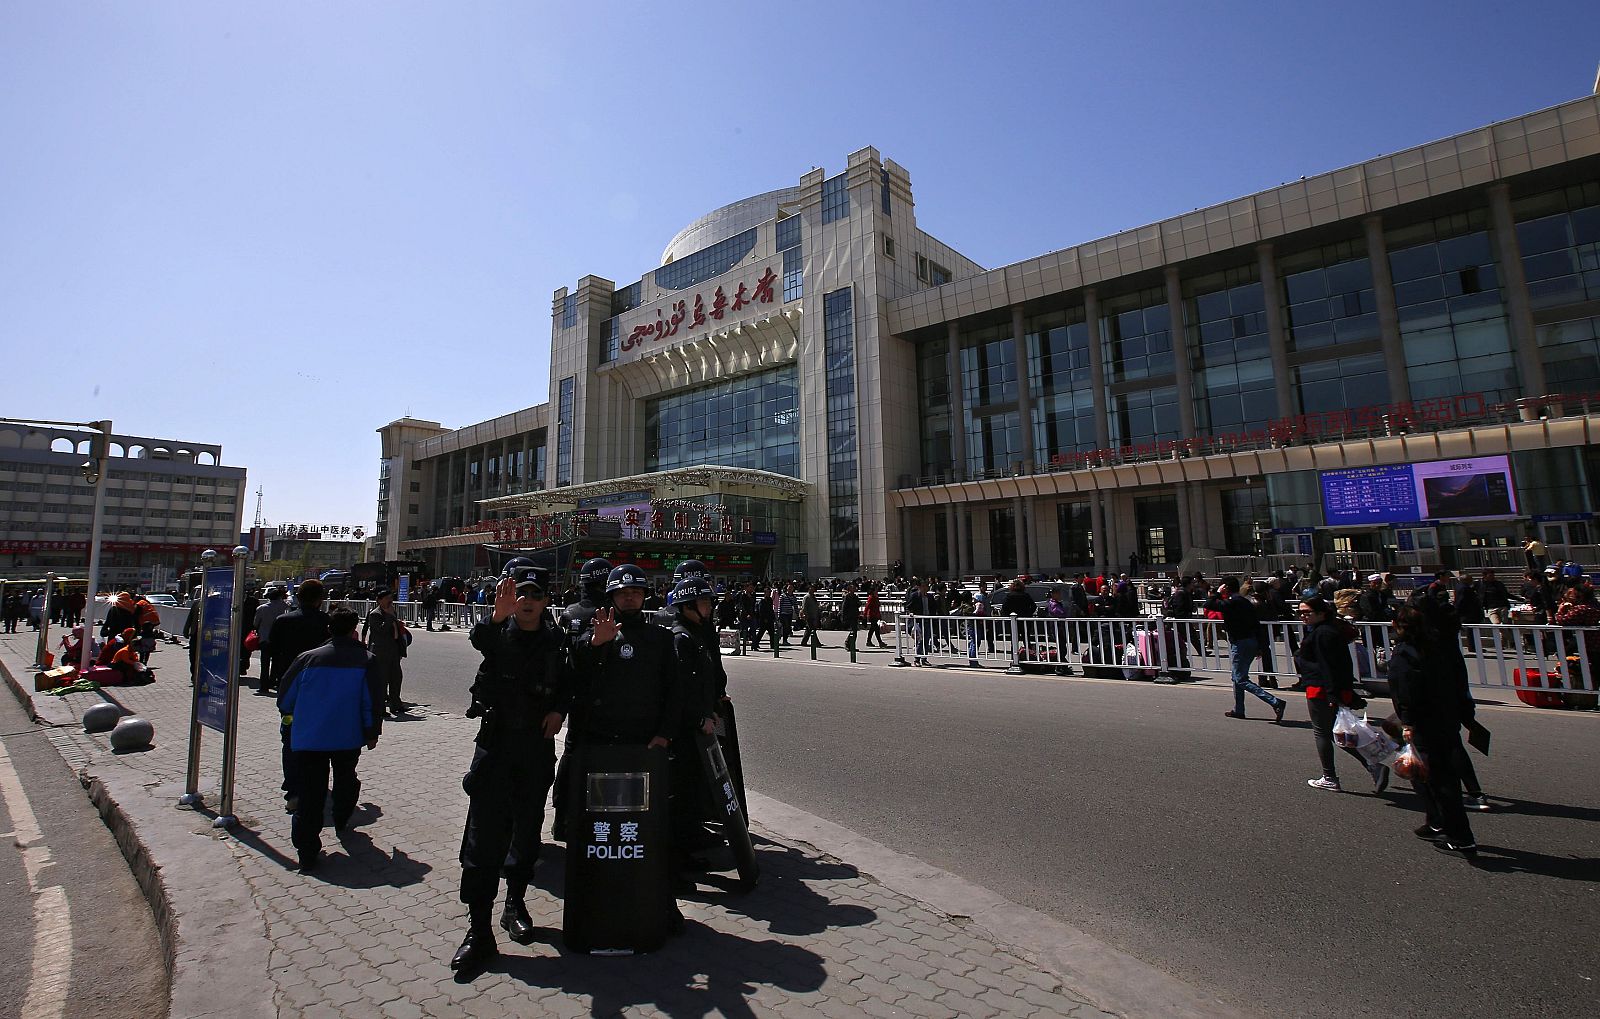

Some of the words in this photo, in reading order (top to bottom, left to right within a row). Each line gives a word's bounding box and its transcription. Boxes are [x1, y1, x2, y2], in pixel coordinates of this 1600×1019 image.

[677, 586, 698, 599] POLICE
[592, 820, 640, 843] 警察
[586, 844, 645, 860] POLICE
